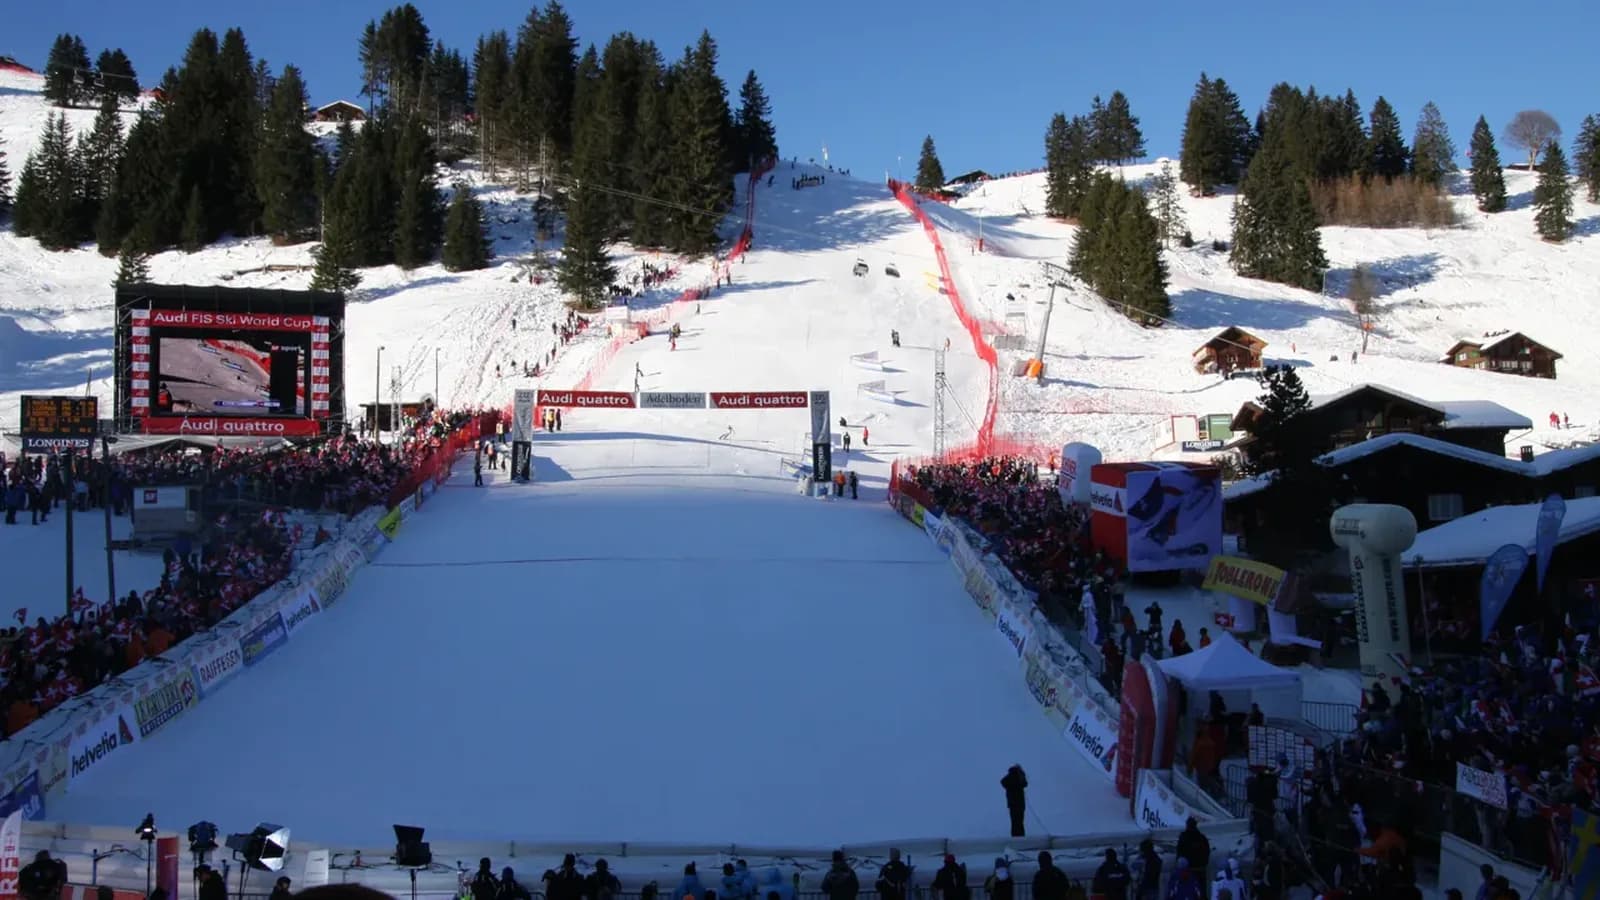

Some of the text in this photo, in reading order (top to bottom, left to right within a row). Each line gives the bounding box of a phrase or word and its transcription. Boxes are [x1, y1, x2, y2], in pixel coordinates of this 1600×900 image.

[154, 312, 311, 329] Audi FIS Ski World Cup
[540, 392, 573, 405] Audi
[576, 394, 630, 408] quattro
[718, 394, 751, 406] Audi
[754, 395, 805, 408] quattro
[180, 419, 285, 435] Audi quattro
[28, 438, 90, 448] LONGINES
[1069, 715, 1104, 759] helvetia
[71, 731, 118, 778] helvetia
